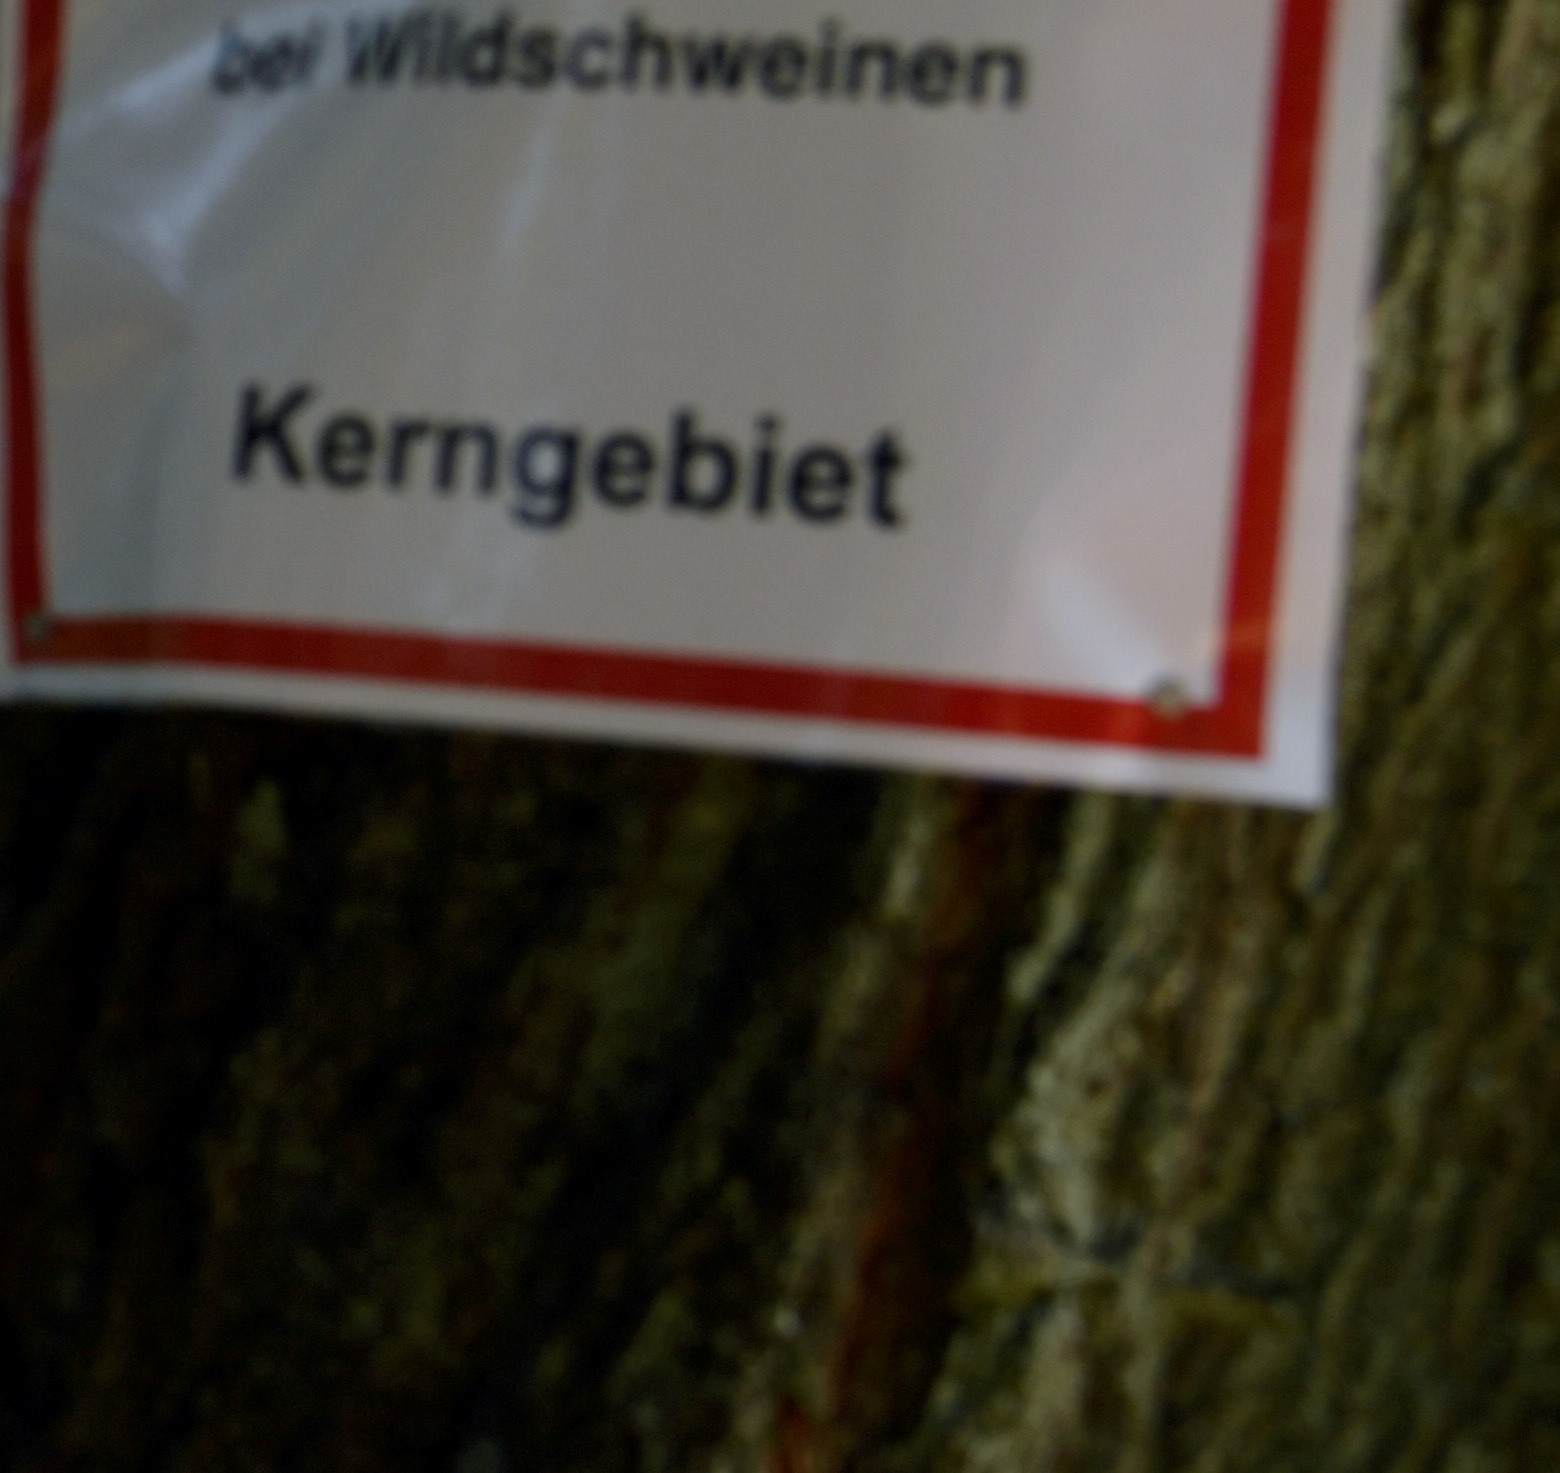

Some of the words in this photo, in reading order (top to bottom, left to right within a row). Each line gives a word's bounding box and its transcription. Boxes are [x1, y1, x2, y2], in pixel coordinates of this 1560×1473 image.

[211, 18, 326, 94] bei
[346, 9, 1027, 109] Wildschweinen
[231, 382, 907, 529] Kerngebiet
